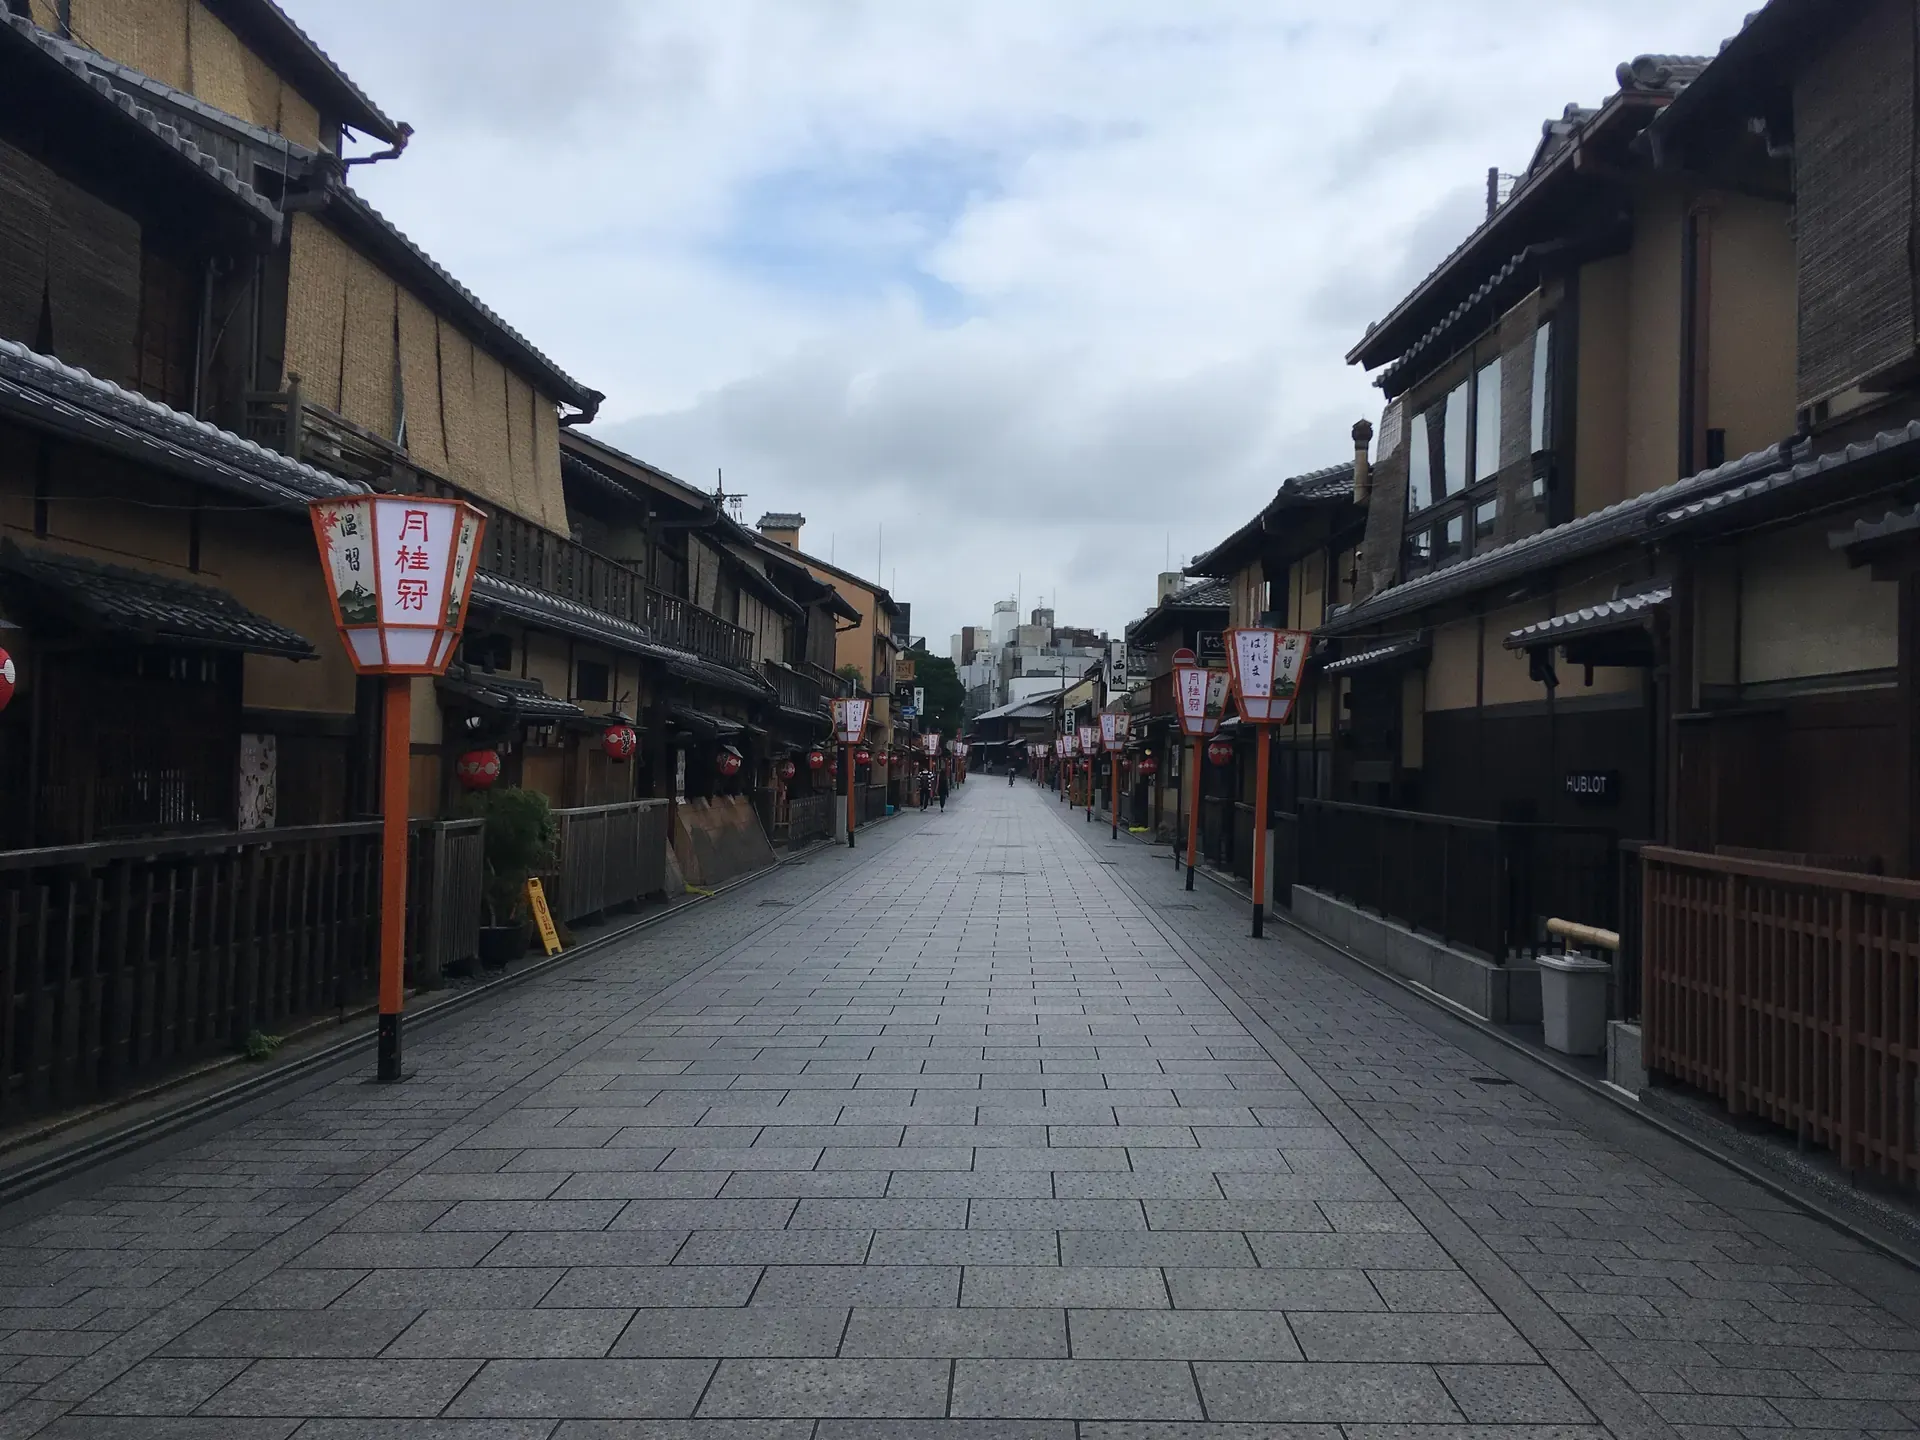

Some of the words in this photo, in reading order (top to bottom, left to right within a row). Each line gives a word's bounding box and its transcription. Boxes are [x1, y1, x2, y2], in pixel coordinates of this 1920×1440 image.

[394, 509, 431, 612] 月桂冠
[1566, 775, 1607, 793] HUBLOT
